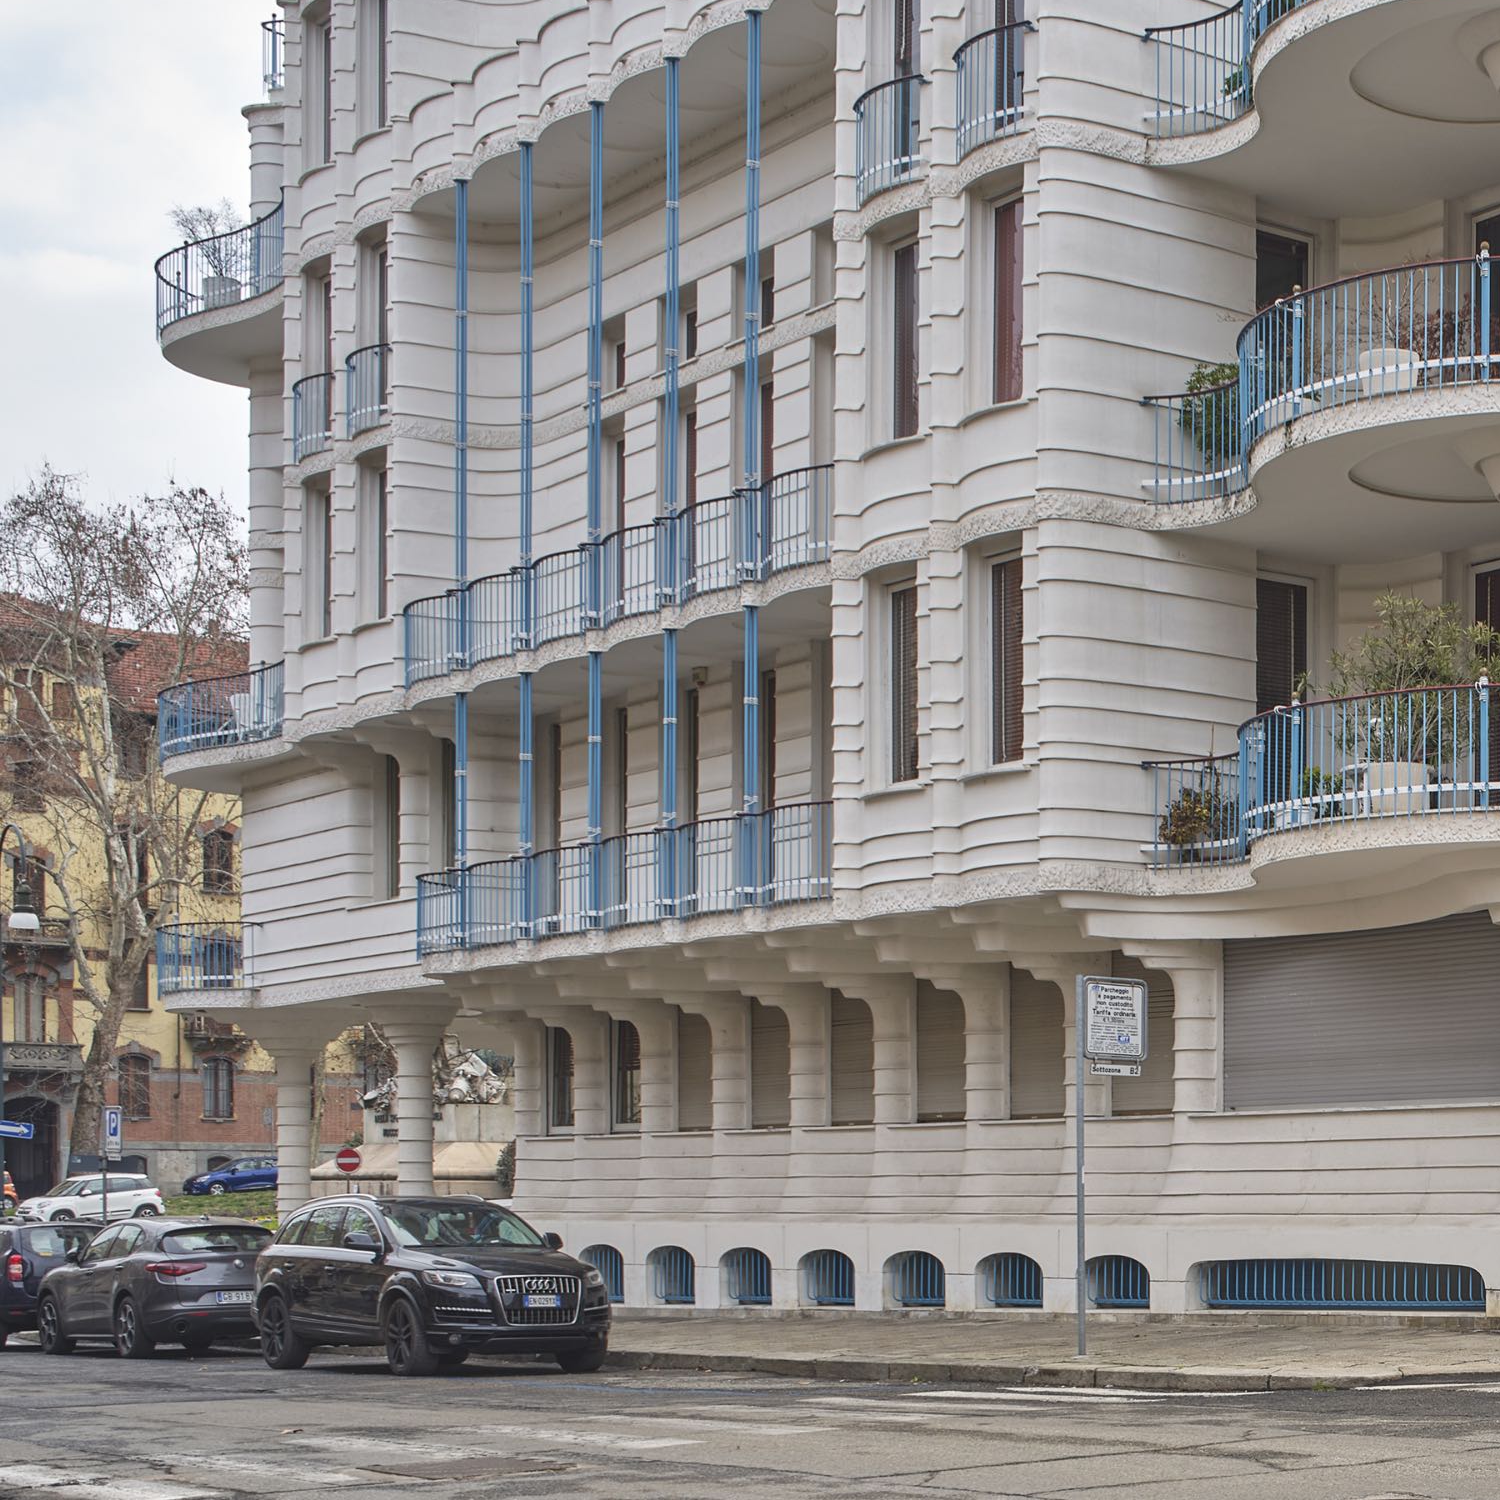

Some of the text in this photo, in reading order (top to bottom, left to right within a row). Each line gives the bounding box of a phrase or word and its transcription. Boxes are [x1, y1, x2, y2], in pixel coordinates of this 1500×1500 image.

[1100, 986, 1129, 995] Parcheggio
[1092, 1008, 1111, 1016] Tariffa
[1130, 1067, 1139, 1075] B2
[110, 1113, 117, 1133] P
